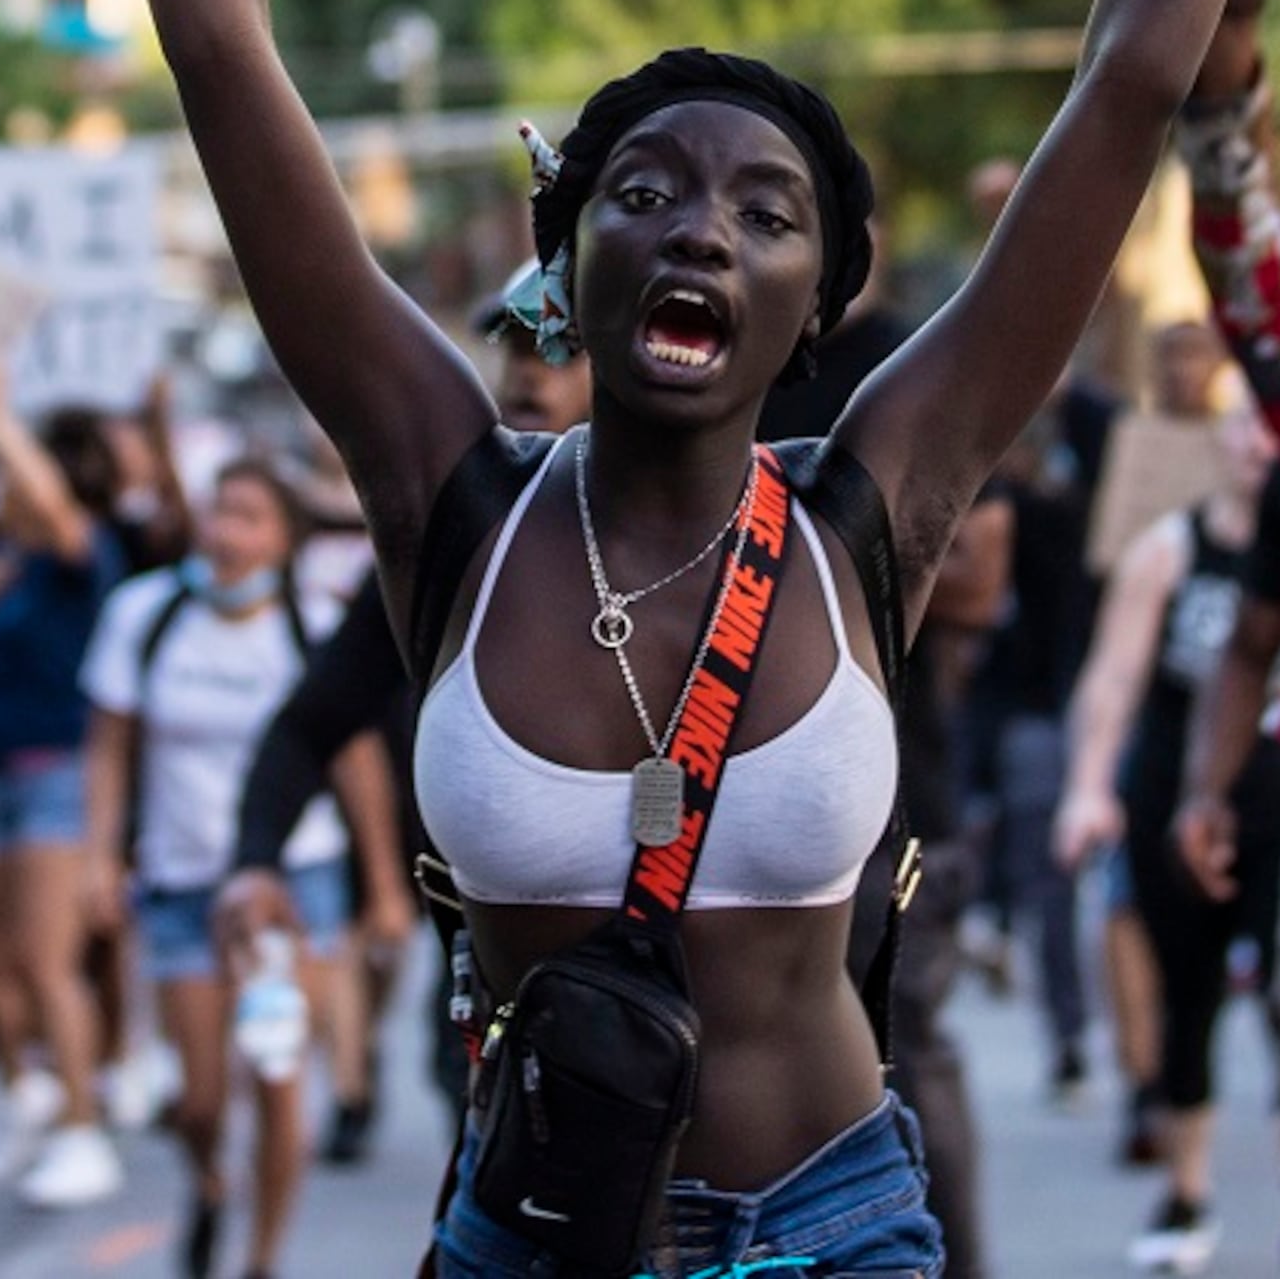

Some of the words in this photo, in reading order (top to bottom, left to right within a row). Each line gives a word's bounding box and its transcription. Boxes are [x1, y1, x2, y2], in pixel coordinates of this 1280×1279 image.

[734, 459, 788, 560] NIKE
[709, 552, 774, 672] NIKE
[670, 666, 742, 790] NIKE
